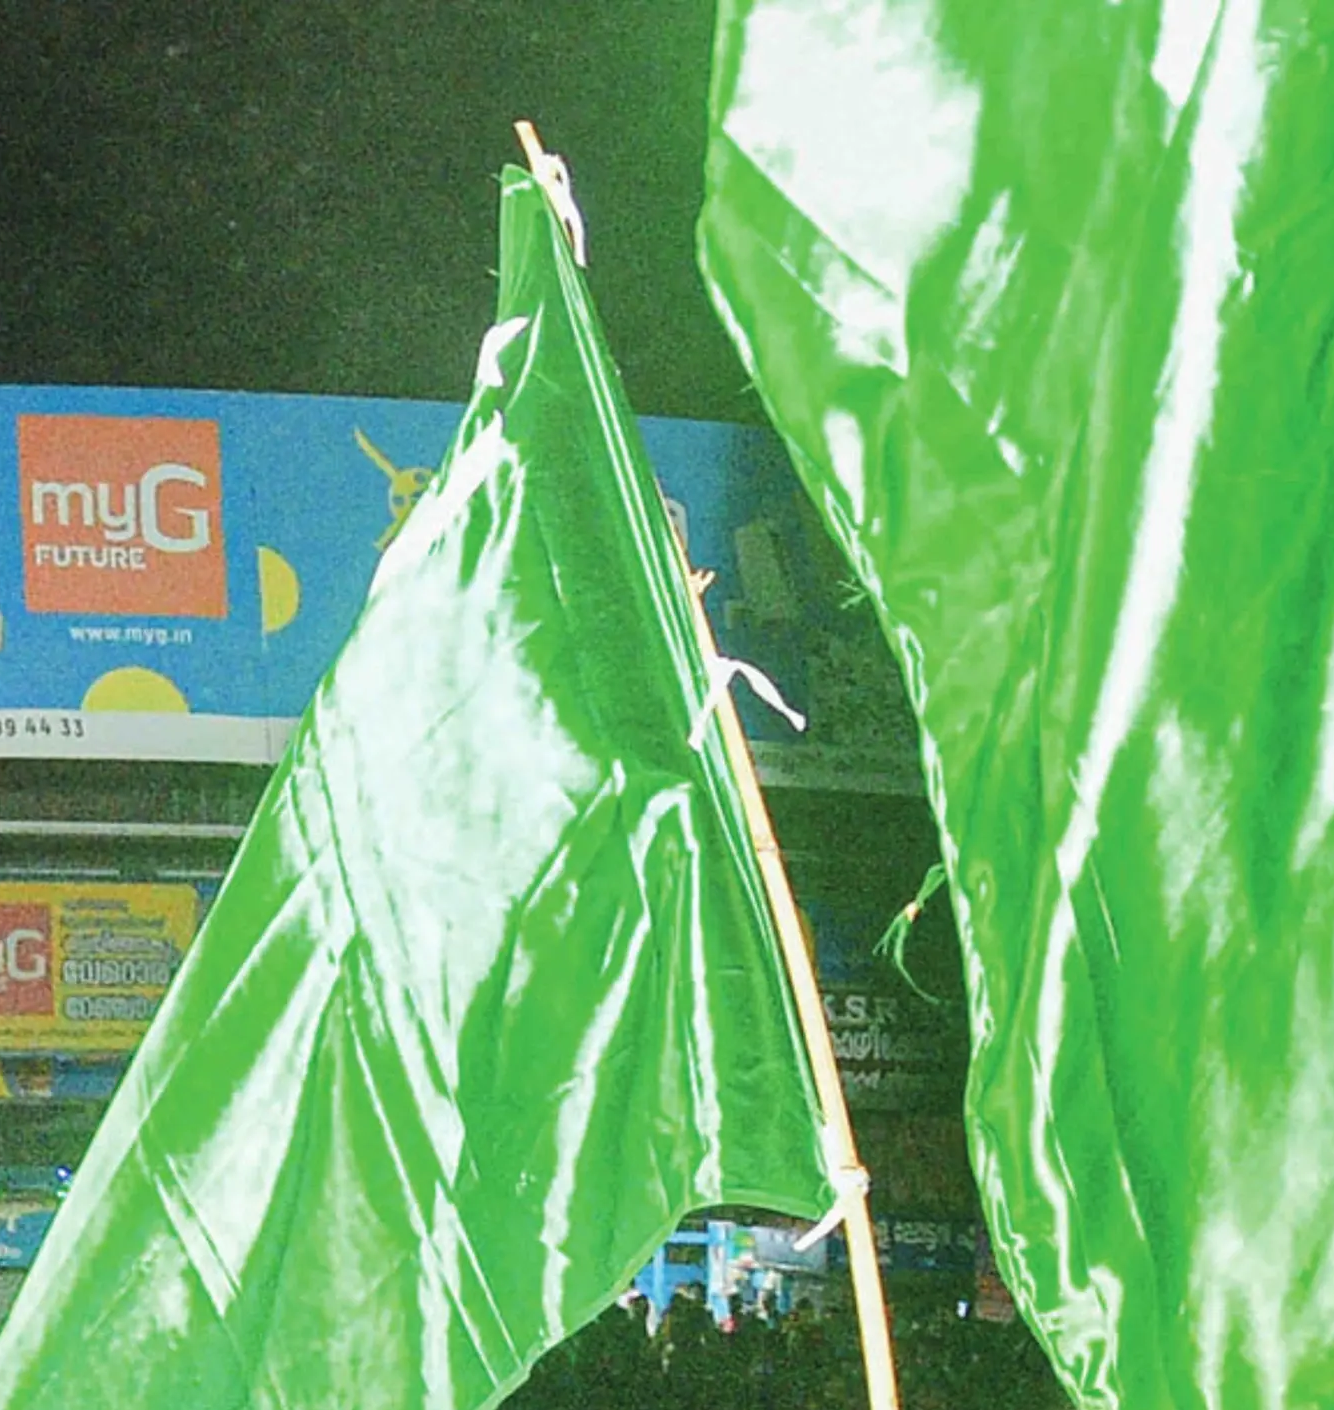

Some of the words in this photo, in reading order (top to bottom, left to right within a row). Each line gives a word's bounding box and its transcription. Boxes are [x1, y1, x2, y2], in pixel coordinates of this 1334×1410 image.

[31, 463, 211, 552] myG
[35, 544, 147, 570] FUTURE
[69, 626, 193, 645] www.myg.in
[24, 718, 52, 737] 44
[59, 717, 86, 738] 33
